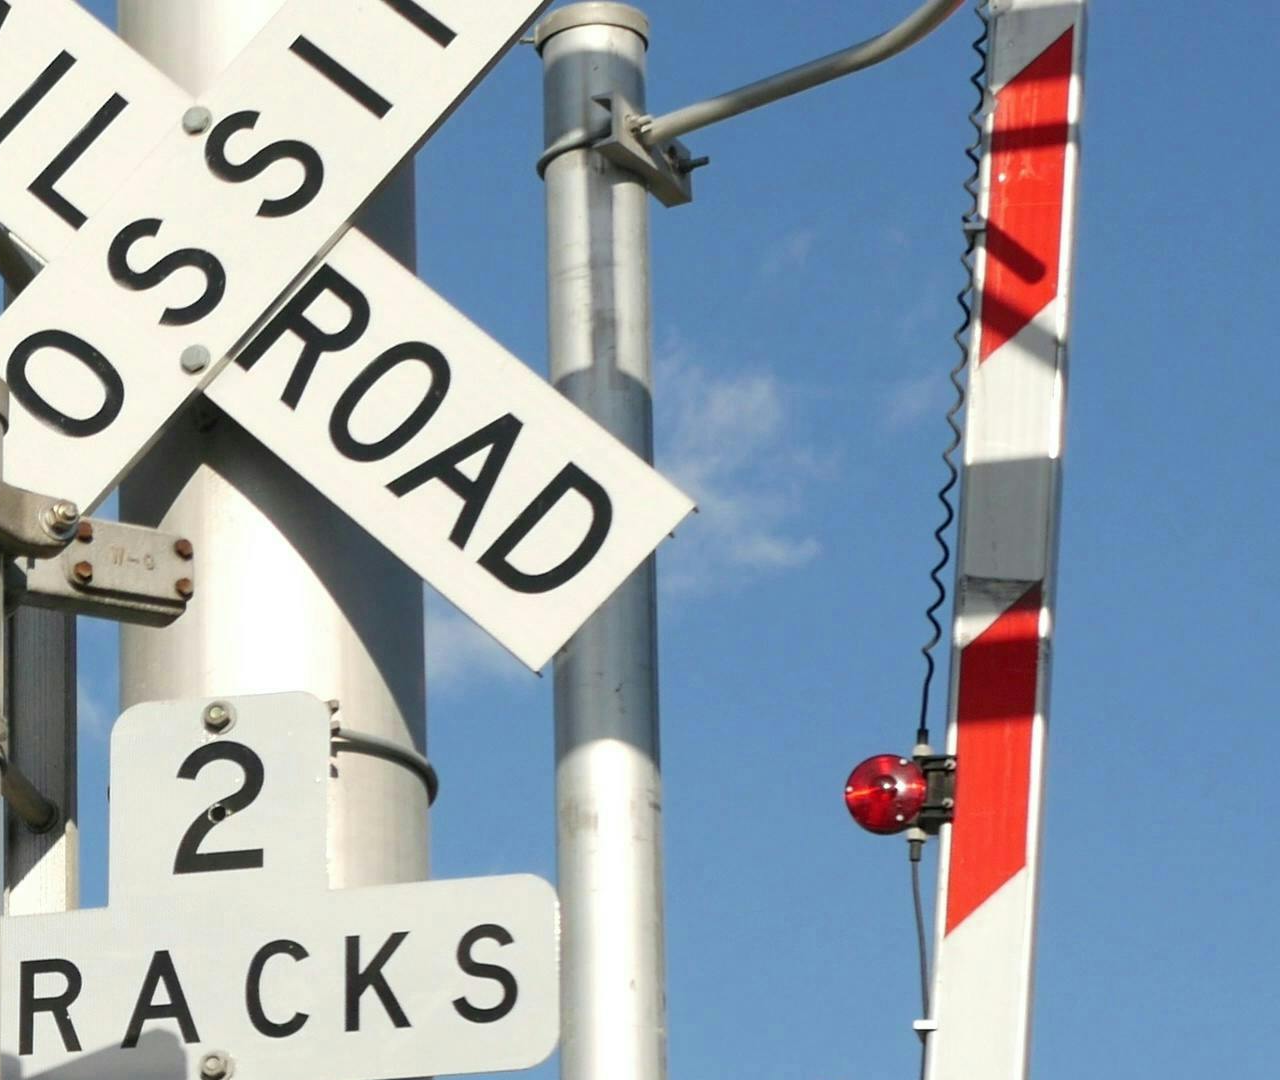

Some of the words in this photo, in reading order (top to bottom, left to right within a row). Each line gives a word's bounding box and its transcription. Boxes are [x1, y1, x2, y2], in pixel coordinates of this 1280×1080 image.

[234, 262, 613, 594] ROAD
[173, 740, 265, 875] 2
[19, 923, 518, 1056] RACKS
